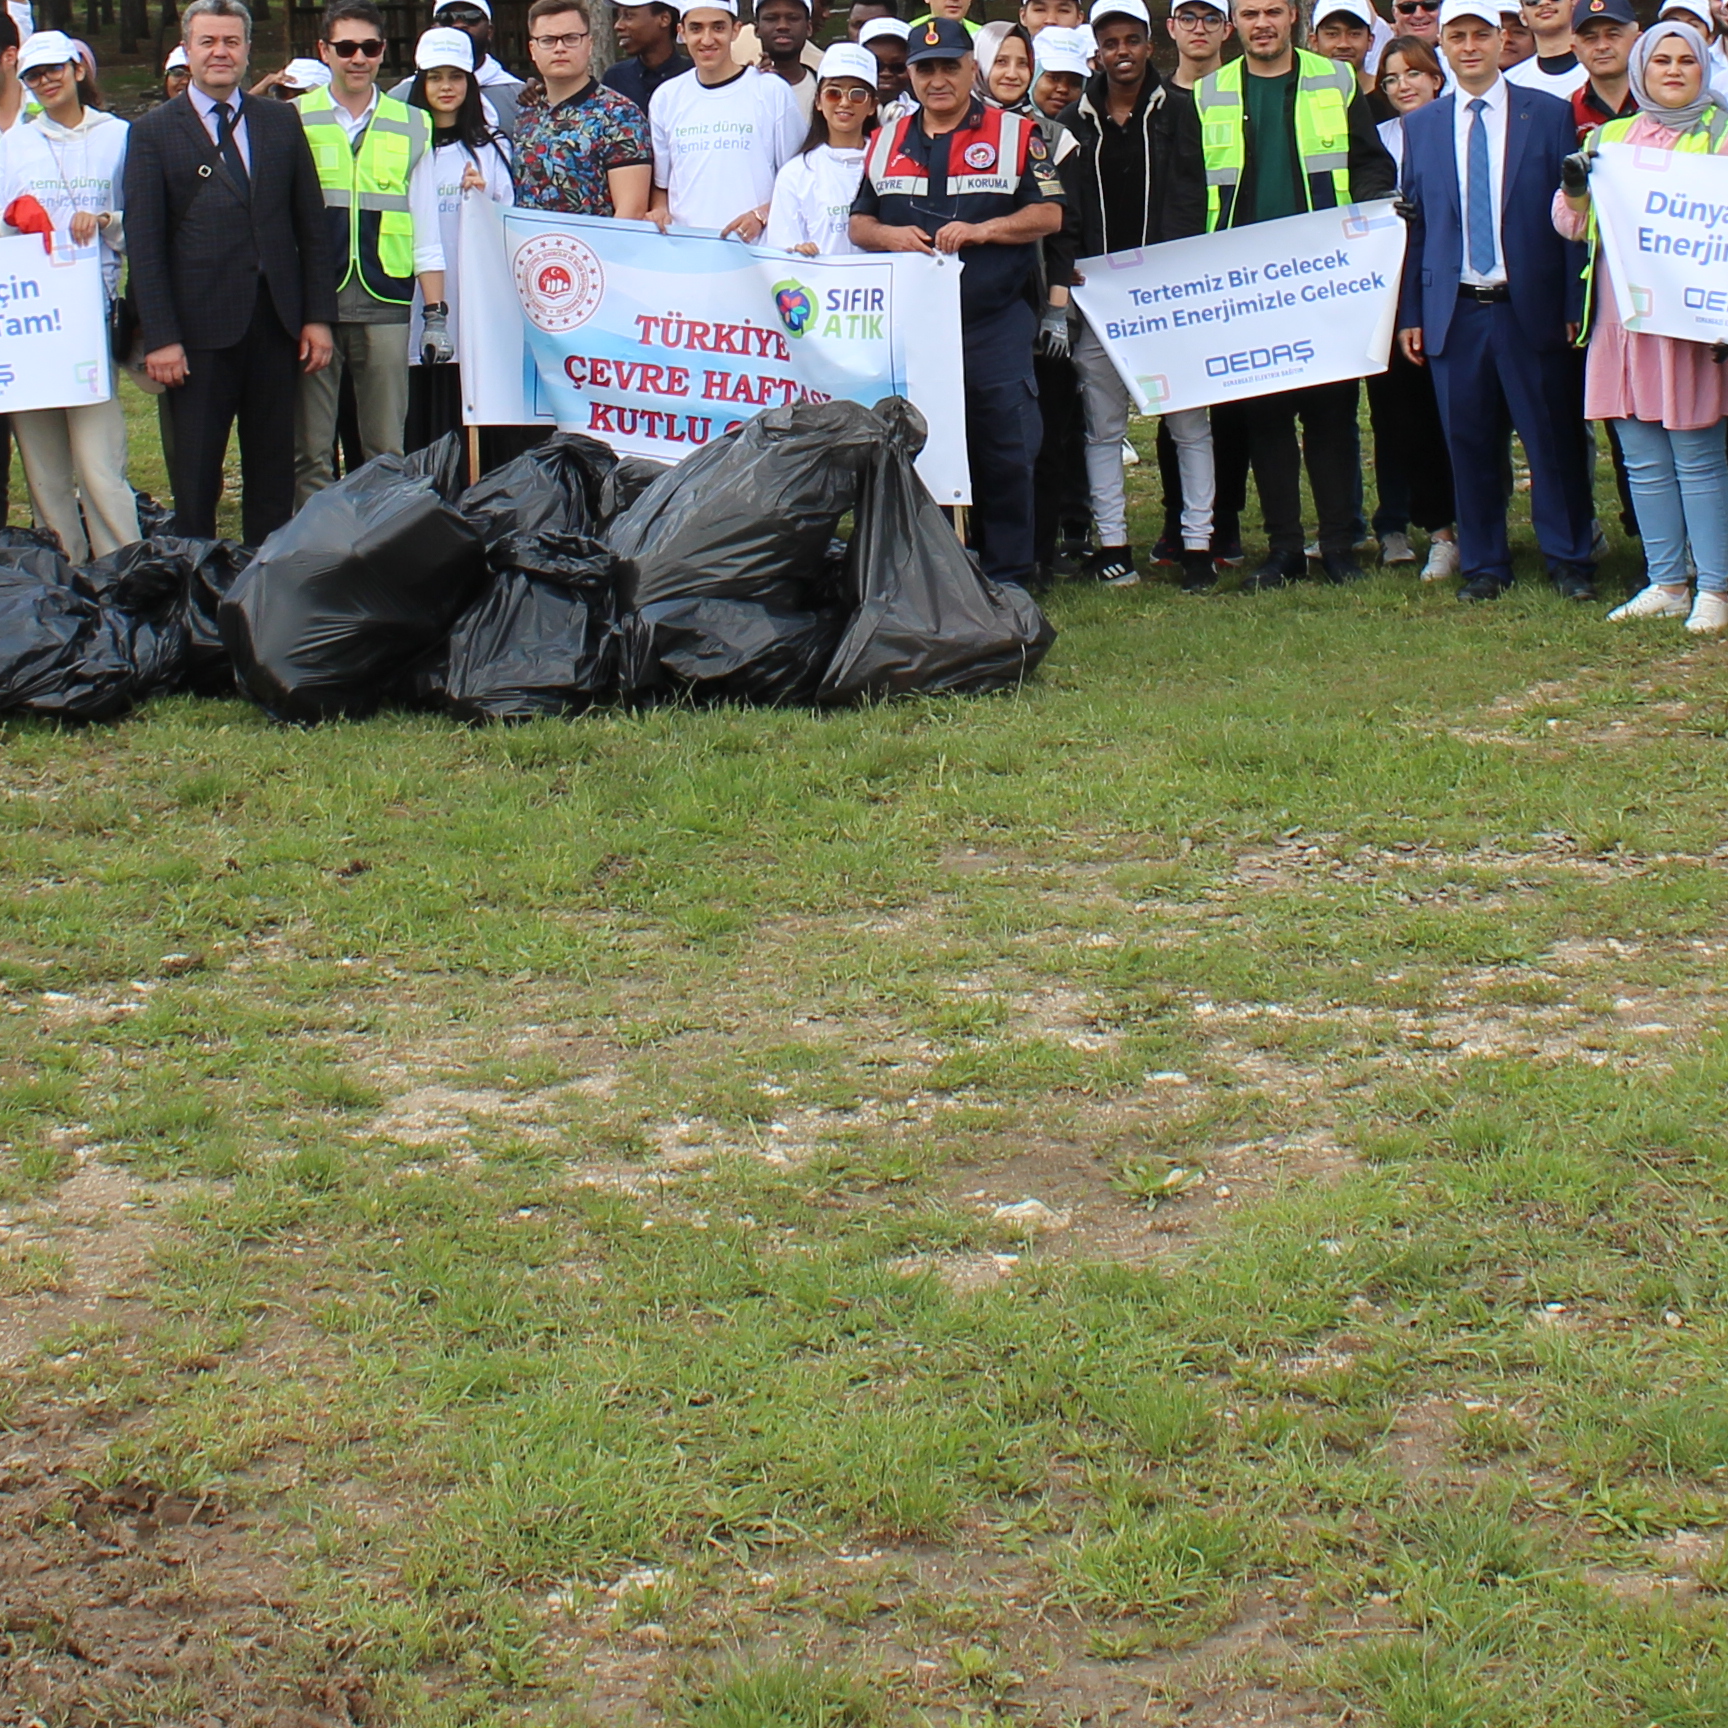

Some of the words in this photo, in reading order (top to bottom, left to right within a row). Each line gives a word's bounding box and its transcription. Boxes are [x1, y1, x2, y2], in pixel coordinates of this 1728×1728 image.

[676, 123, 709, 137] temiz
[713, 121, 754, 135] dünya
[676, 139, 710, 154] temiz
[714, 137, 751, 151] deniz
[70, 176, 111, 190] dünya
[876, 179, 903, 193] ÇEVRE
[967, 178, 1008, 190] KORUMA
[827, 204, 851, 217] tem
[1129, 274, 1223, 306] Tertemiz
[1228, 266, 1258, 288] Bir
[1264, 249, 1350, 281] Gelecek
[826, 288, 884, 312] SIFIR
[1106, 313, 1168, 340] Bizim
[1173, 290, 1296, 328] Enerjimizle
[1301, 271, 1386, 303] Gelecek
[635, 310, 790, 362] TÜRKİYE
[822, 314, 884, 340] ATIK
[1205, 339, 1314, 377] OEDAŞ
[564, 355, 689, 390] ÇEVRE
[587, 401, 710, 445] KUTLU
